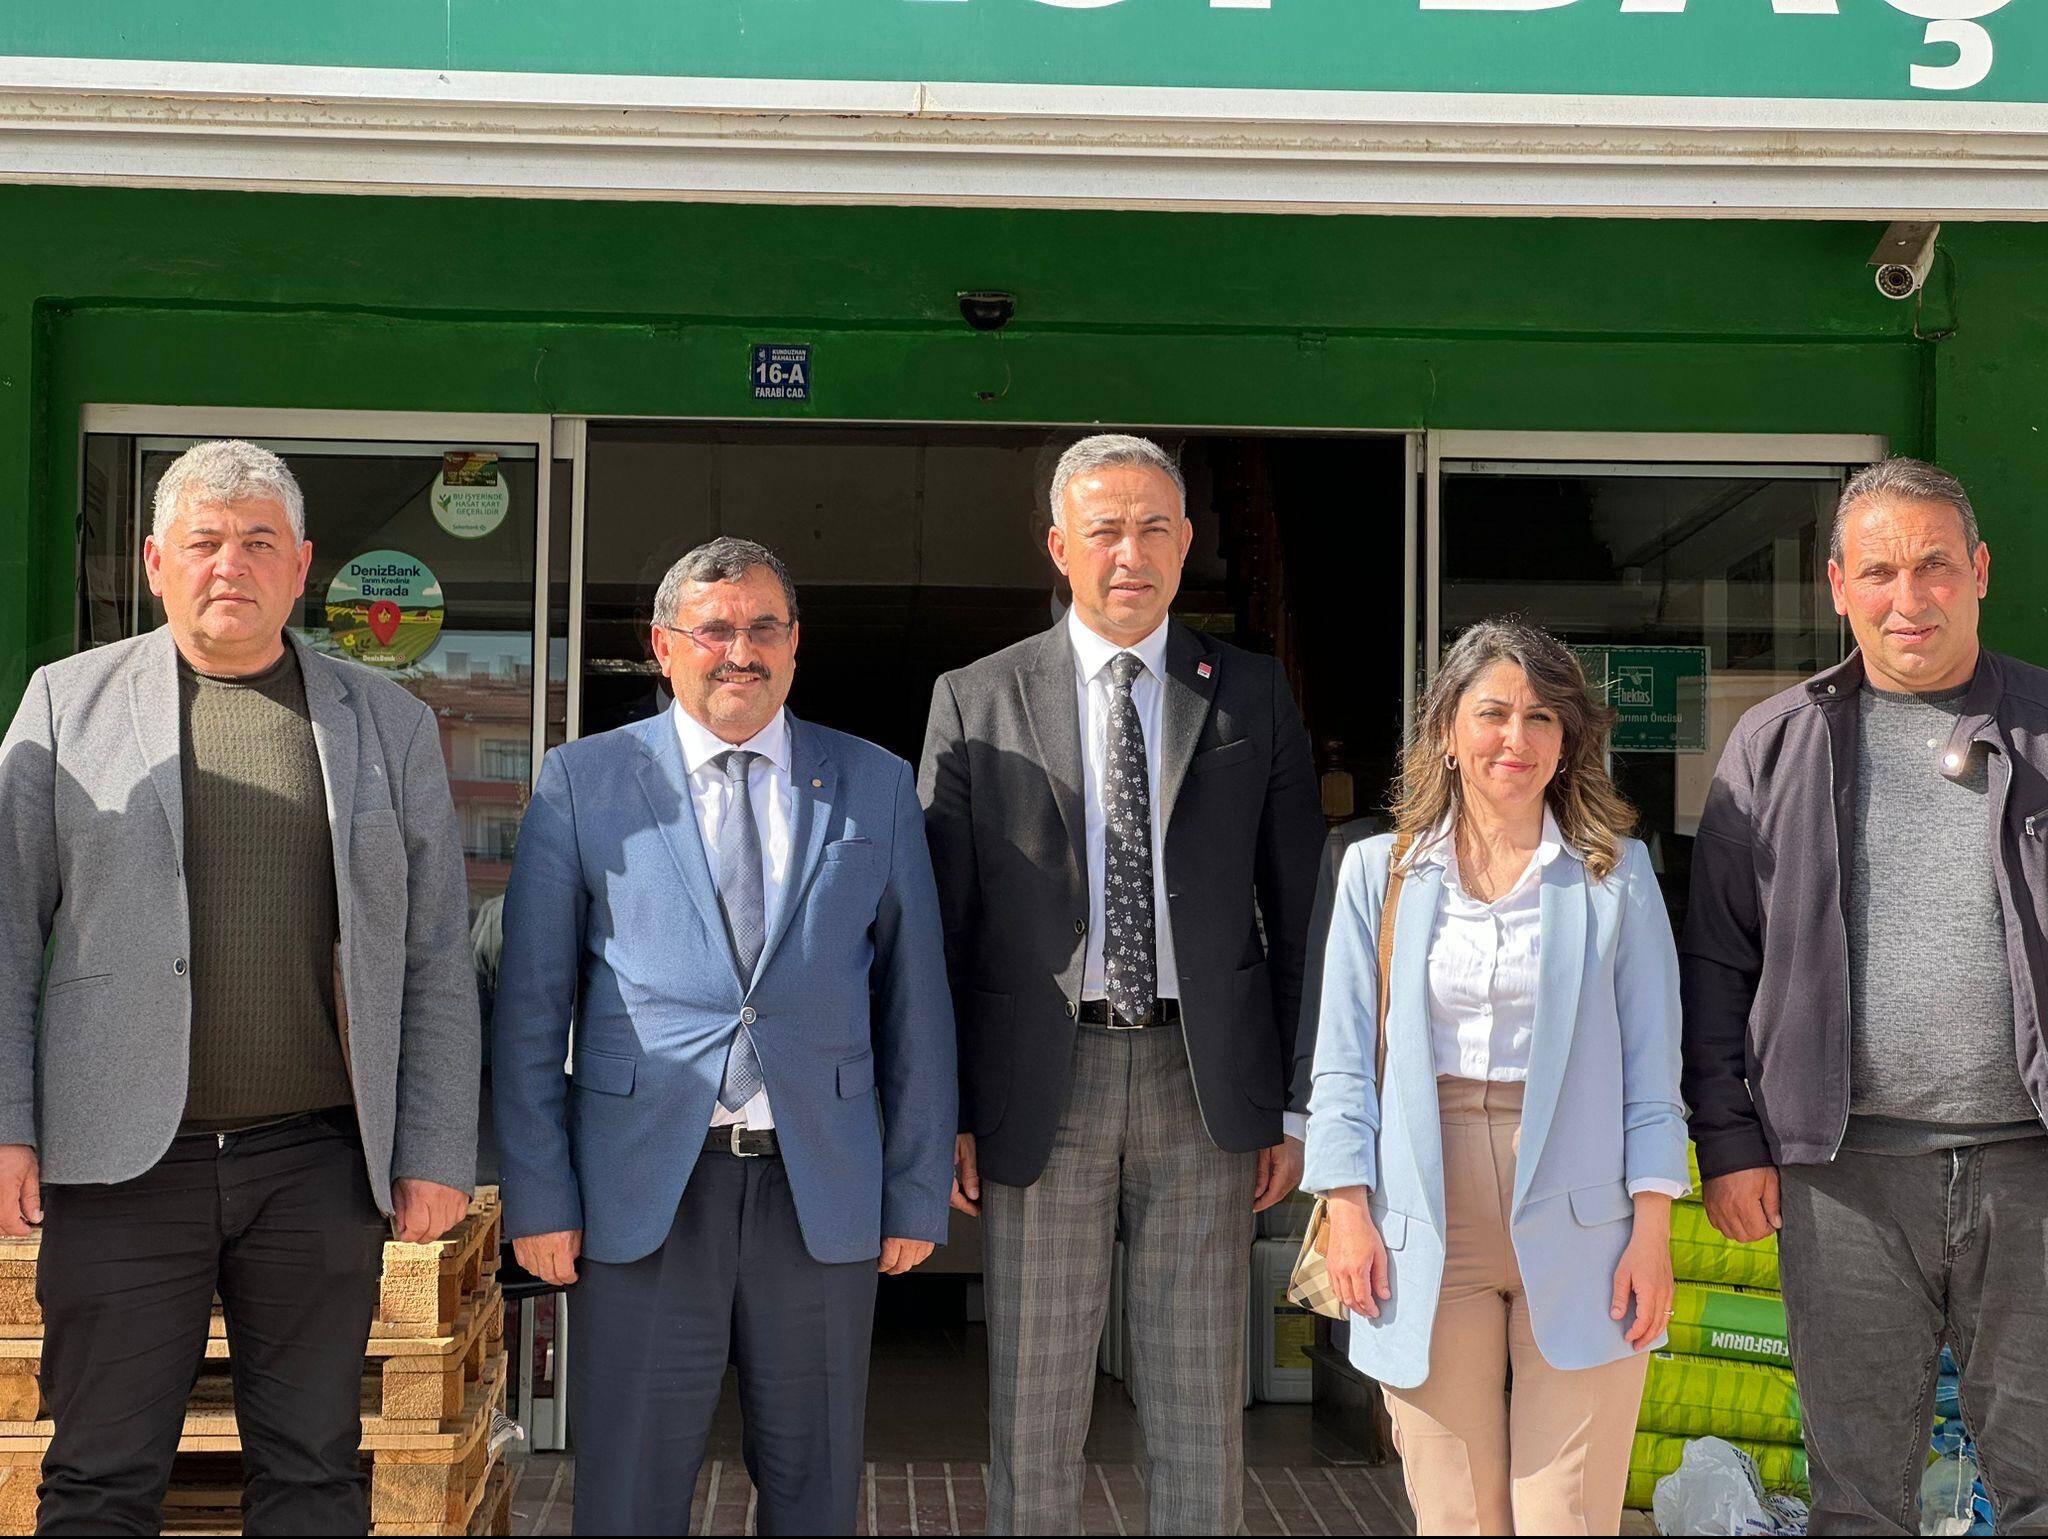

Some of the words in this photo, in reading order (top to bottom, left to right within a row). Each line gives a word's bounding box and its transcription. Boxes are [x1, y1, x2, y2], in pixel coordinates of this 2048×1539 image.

[756, 362, 805, 384] 16-A
[755, 386, 785, 398] FARABİ
[786, 388, 806, 398] CAD.
[351, 564, 421, 577] DenizBank
[362, 585, 409, 596] Burada
